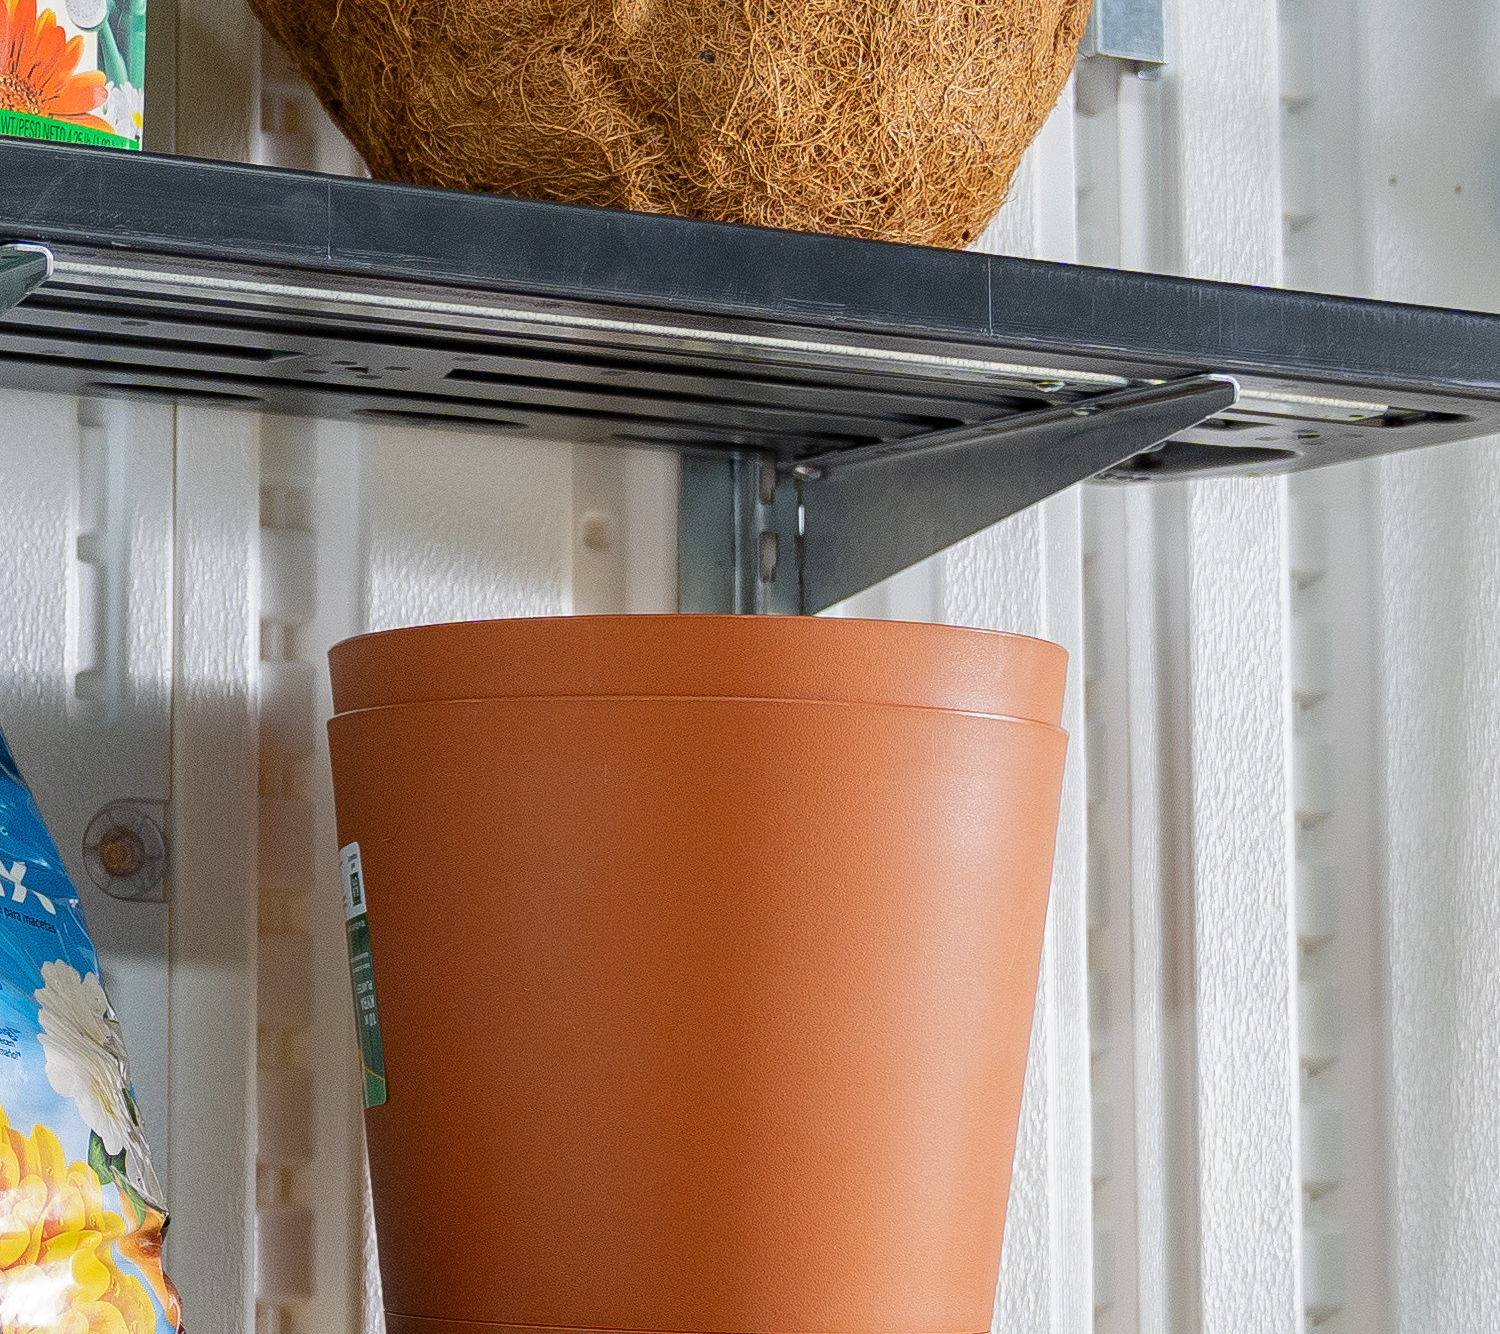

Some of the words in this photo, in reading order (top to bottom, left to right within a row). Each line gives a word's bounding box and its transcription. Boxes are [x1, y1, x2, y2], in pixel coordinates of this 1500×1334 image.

[1, 116, 41, 138] WT/PESO
[3, 907, 22, 924] para
[22, 913, 57, 934] macetas
